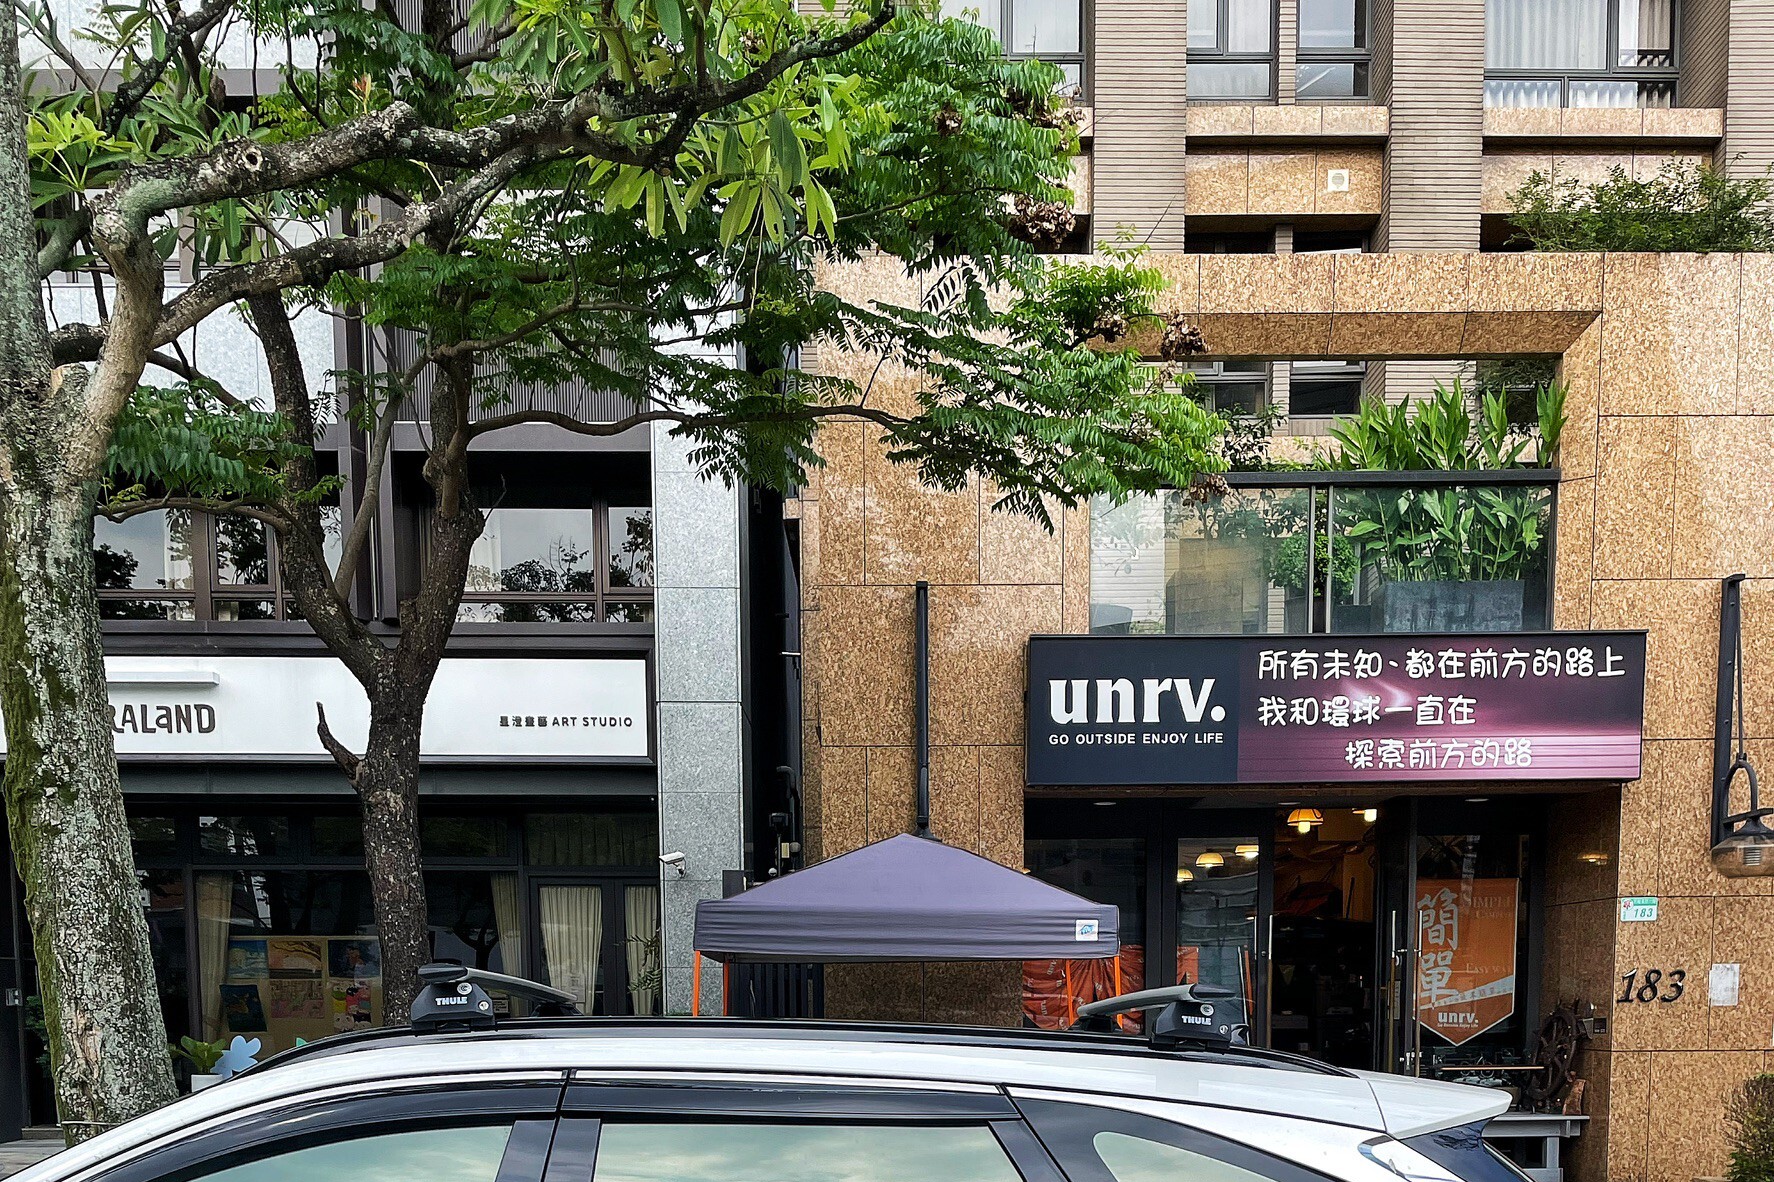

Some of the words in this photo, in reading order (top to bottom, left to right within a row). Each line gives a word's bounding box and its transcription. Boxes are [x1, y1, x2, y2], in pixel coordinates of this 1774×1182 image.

[1258, 647, 1625, 680] 所有未知、都在前方的路上
[1049, 677, 1226, 724] unrv.
[1257, 695, 1477, 727] 我和環球一直在
[551, 716, 578, 727] ART
[582, 716, 633, 728] STUDIO
[1048, 733, 1070, 745] GO
[1075, 733, 1136, 745] OUTSIDE
[1142, 732, 1189, 745] ENJOY
[1194, 732, 1224, 744] LIFE
[1344, 738, 1532, 769] 探索前方的路
[1634, 907, 1654, 918] 183
[1616, 967, 1686, 1003] 183
[435, 996, 468, 1006] THULE
[1181, 1014, 1213, 1026] THULE
[1437, 1011, 1479, 1024] unrv.
